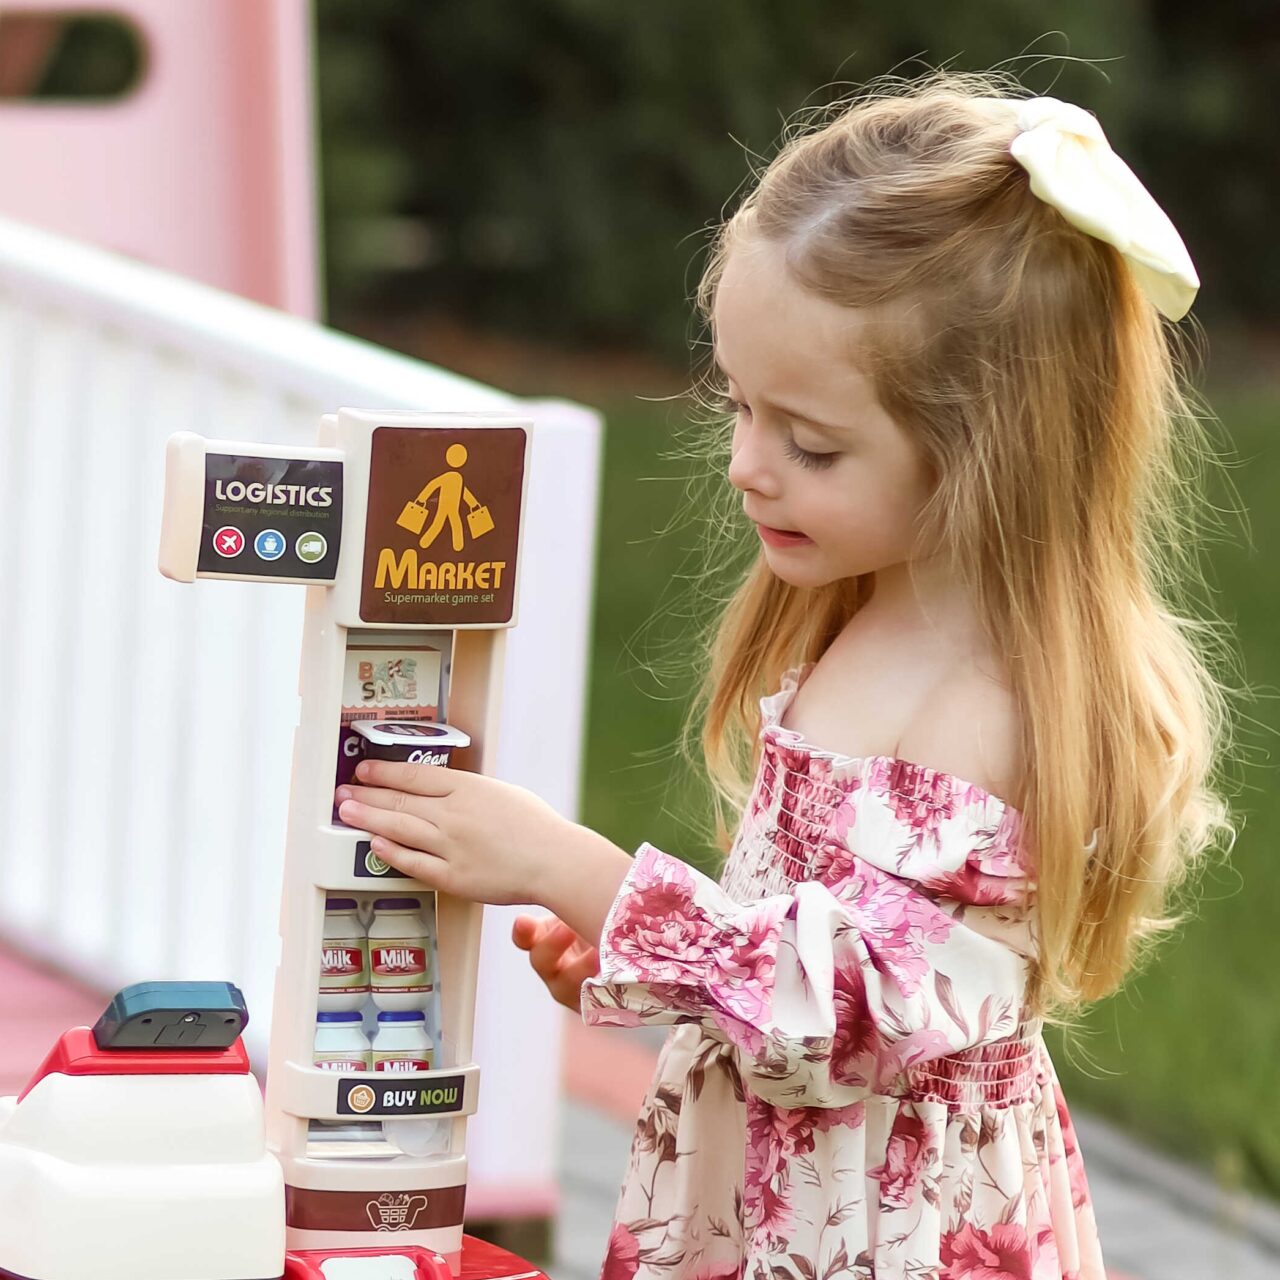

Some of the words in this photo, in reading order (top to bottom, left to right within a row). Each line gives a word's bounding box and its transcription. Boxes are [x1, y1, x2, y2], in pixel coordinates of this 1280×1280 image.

[215, 479, 333, 507] LOGISTICS
[374, 548, 506, 589] MARKET
[384, 591, 450, 605] Supermarket
[452, 595, 479, 606] game
[480, 593, 495, 603] set
[358, 658, 418, 681] BAKE
[362, 680, 418, 702] SALE
[407, 749, 449, 766] Cream
[321, 949, 352, 968] Milk
[380, 949, 415, 968] Milk
[382, 1090, 417, 1107] BUY
[420, 1087, 458, 1106] NOW
